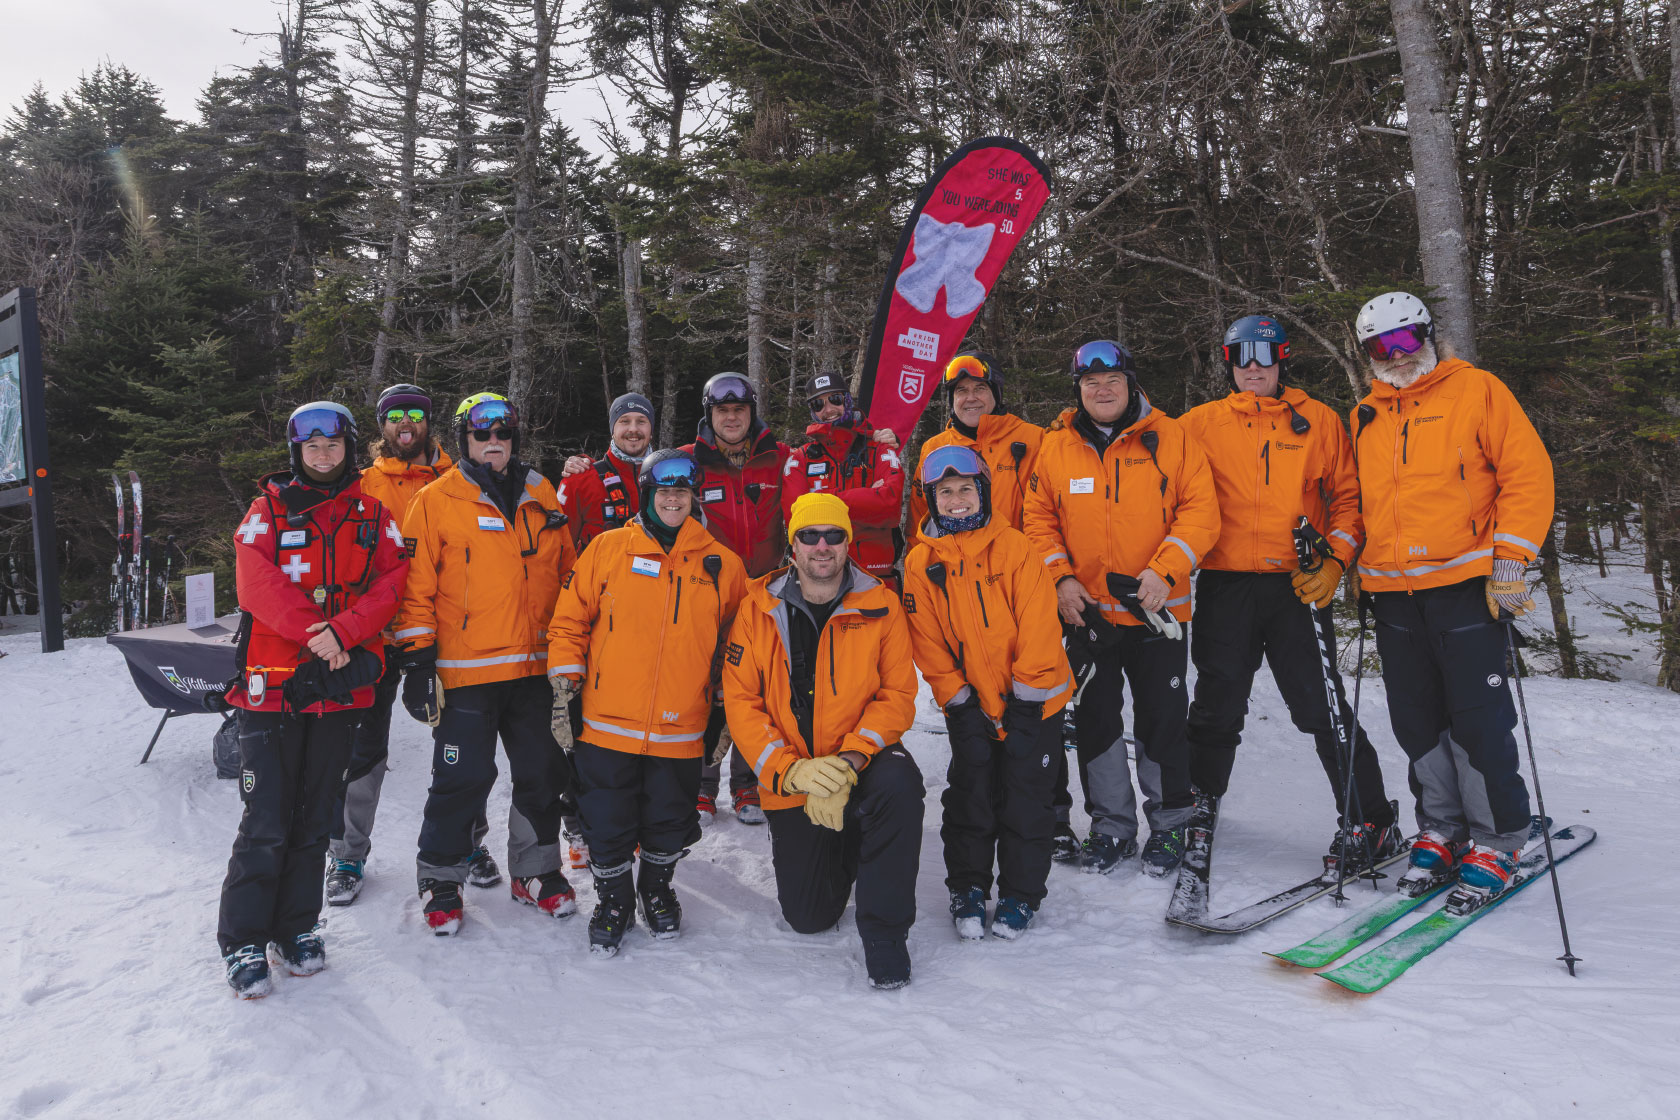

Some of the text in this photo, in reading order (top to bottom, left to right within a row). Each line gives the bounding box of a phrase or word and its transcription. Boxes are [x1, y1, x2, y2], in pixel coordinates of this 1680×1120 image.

[988, 168, 1031, 186] SHE WAS
[1015, 188, 1024, 201] 5.
[942, 188, 1020, 218] YOU WERE DOING
[1000, 218, 1015, 235] 50.
[902, 338, 933, 350] ANOTHER
[1409, 546, 1427, 555] HH
[182, 676, 227, 692] Killingt
[662, 710, 679, 722] HH
